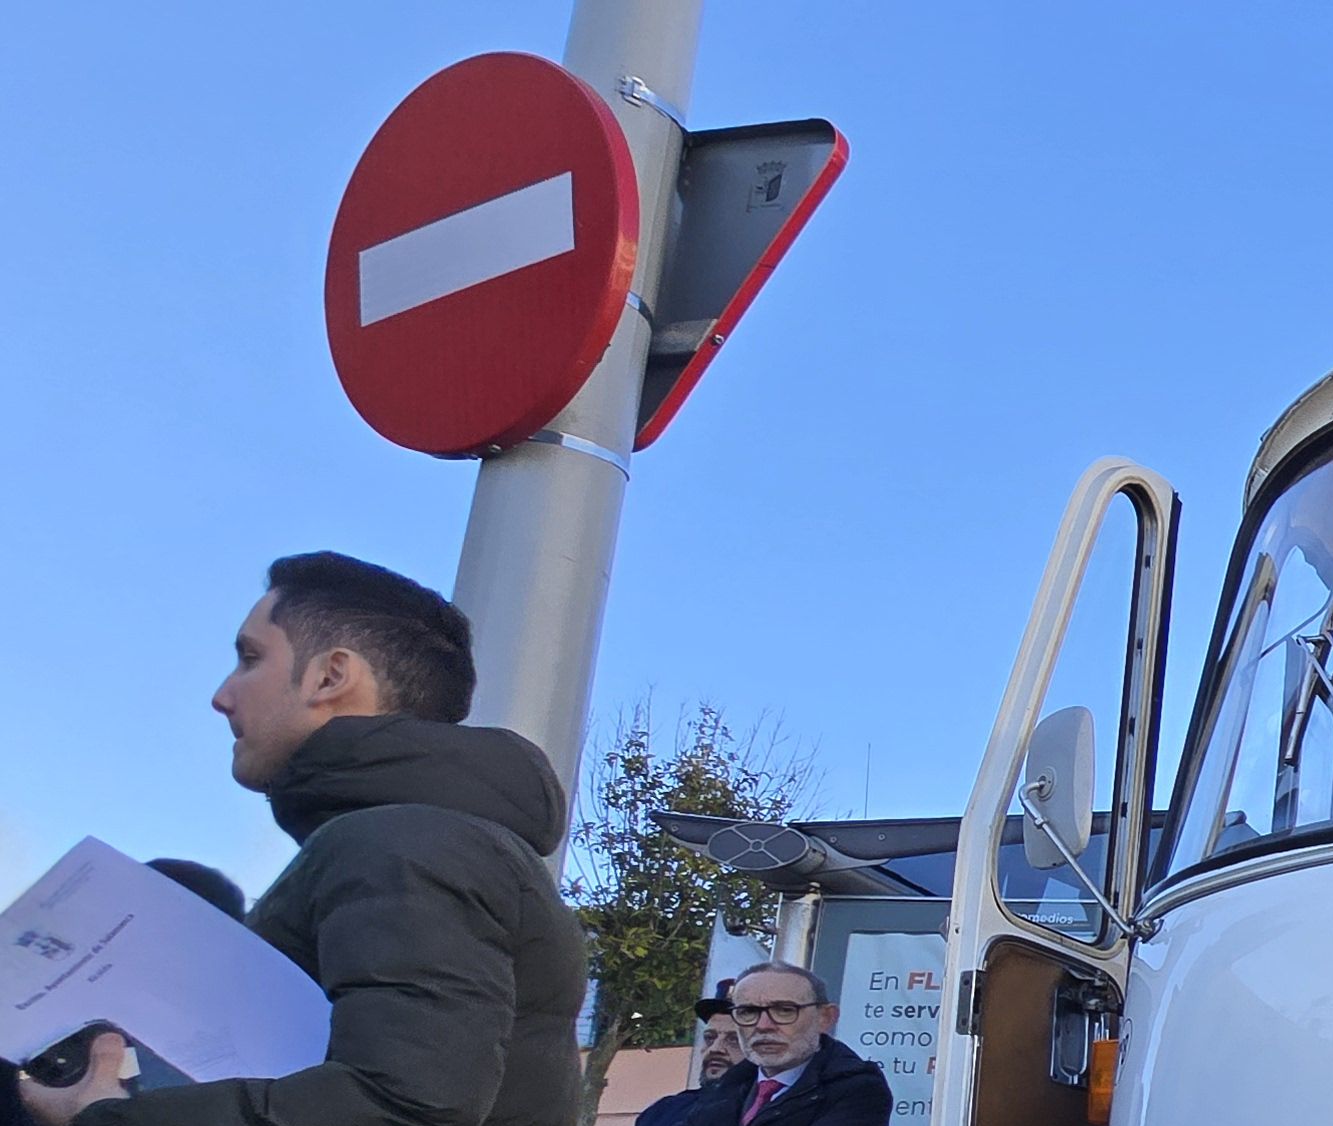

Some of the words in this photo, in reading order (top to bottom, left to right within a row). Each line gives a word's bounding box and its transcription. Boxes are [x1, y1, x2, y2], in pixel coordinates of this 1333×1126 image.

[869, 971, 899, 991] En
[907, 972, 943, 990] FL
[864, 1003, 884, 1019] te
[860, 1031, 932, 1047] como
[893, 1057, 917, 1075] tu
